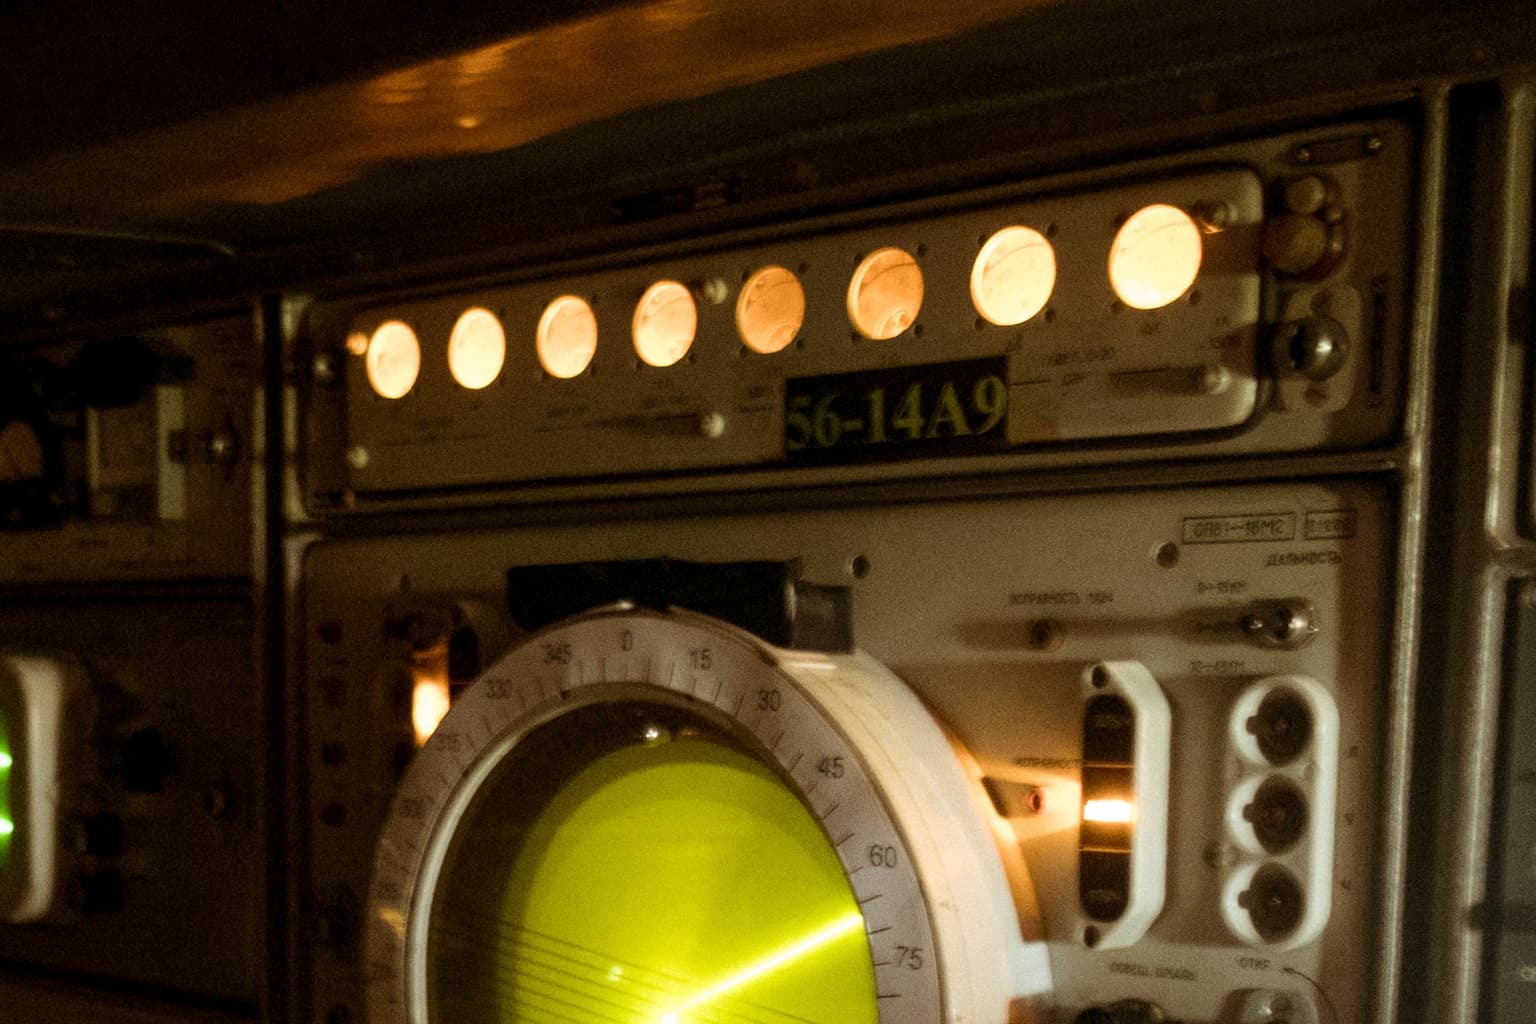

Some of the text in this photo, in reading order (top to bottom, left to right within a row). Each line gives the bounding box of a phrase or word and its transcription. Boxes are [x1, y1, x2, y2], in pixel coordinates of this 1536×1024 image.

[622, 630, 633, 651] 0
[690, 649, 712, 671] 15
[758, 689, 782, 712] 30
[817, 756, 845, 779] 45
[869, 844, 897, 869] 60
[895, 946, 923, 971] 75
